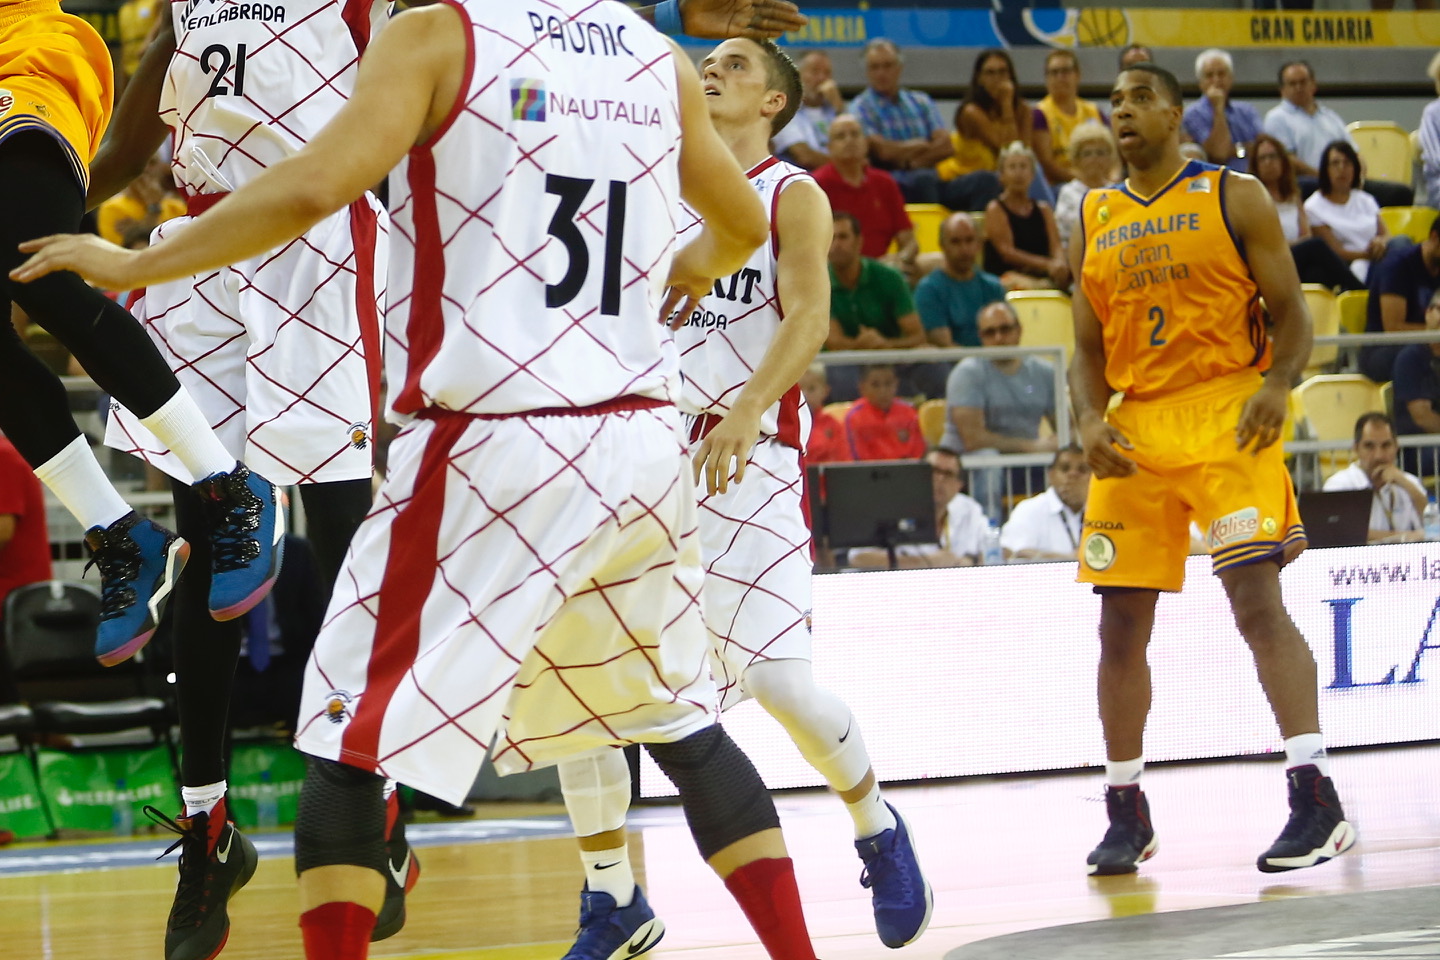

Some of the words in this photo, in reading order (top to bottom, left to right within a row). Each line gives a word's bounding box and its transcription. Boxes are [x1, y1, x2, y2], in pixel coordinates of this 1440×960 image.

[1250, 17, 1295, 42] GRAN
[1302, 17, 1375, 43] CANARIA
[199, 43, 247, 98] 21
[549, 91, 662, 129] NAUTALIA
[545, 173, 628, 317] 31
[1095, 212, 1201, 253] HERBALIFE
[1118, 242, 1174, 269] Gran
[1115, 261, 1190, 293] Canaria
[1148, 305, 1167, 347] 2
[1210, 515, 1258, 547] Kalise
